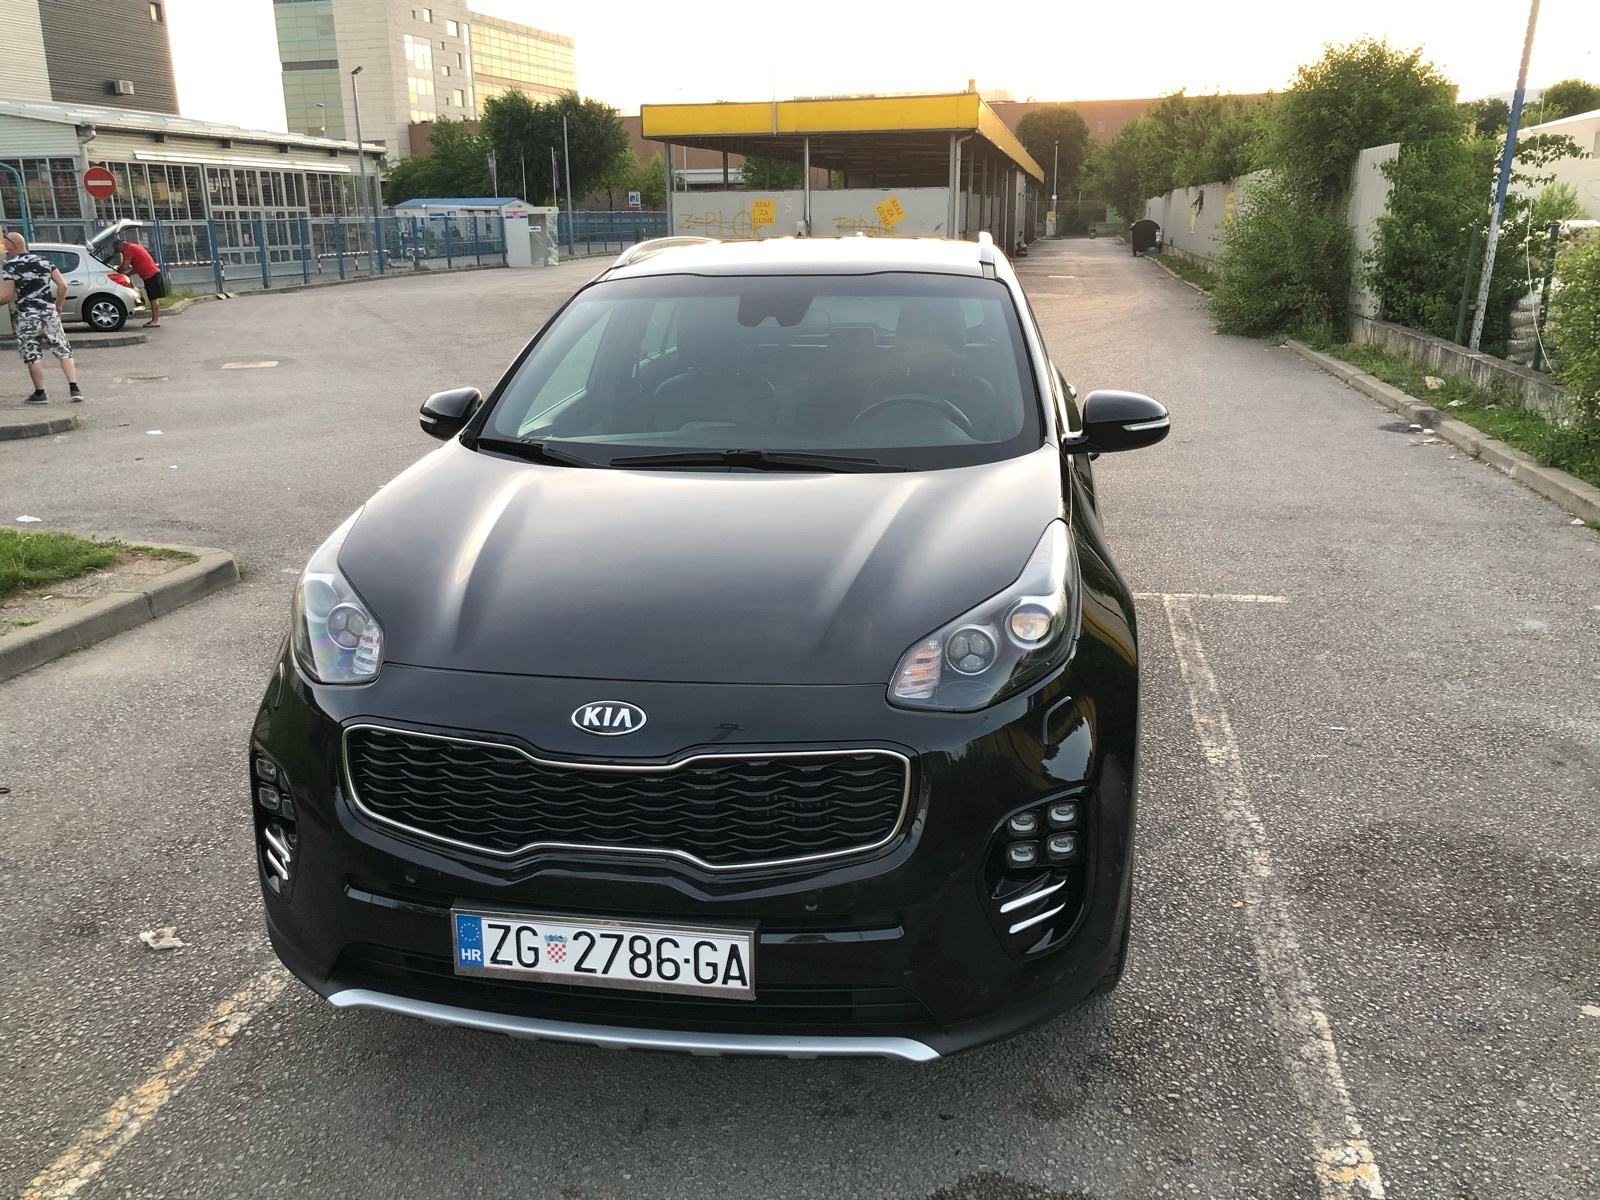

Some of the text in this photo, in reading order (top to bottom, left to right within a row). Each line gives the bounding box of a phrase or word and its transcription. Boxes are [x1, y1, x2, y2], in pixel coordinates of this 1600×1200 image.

[583, 706, 632, 728] KIA
[461, 947, 482, 963] HR
[487, 923, 540, 969] ZG
